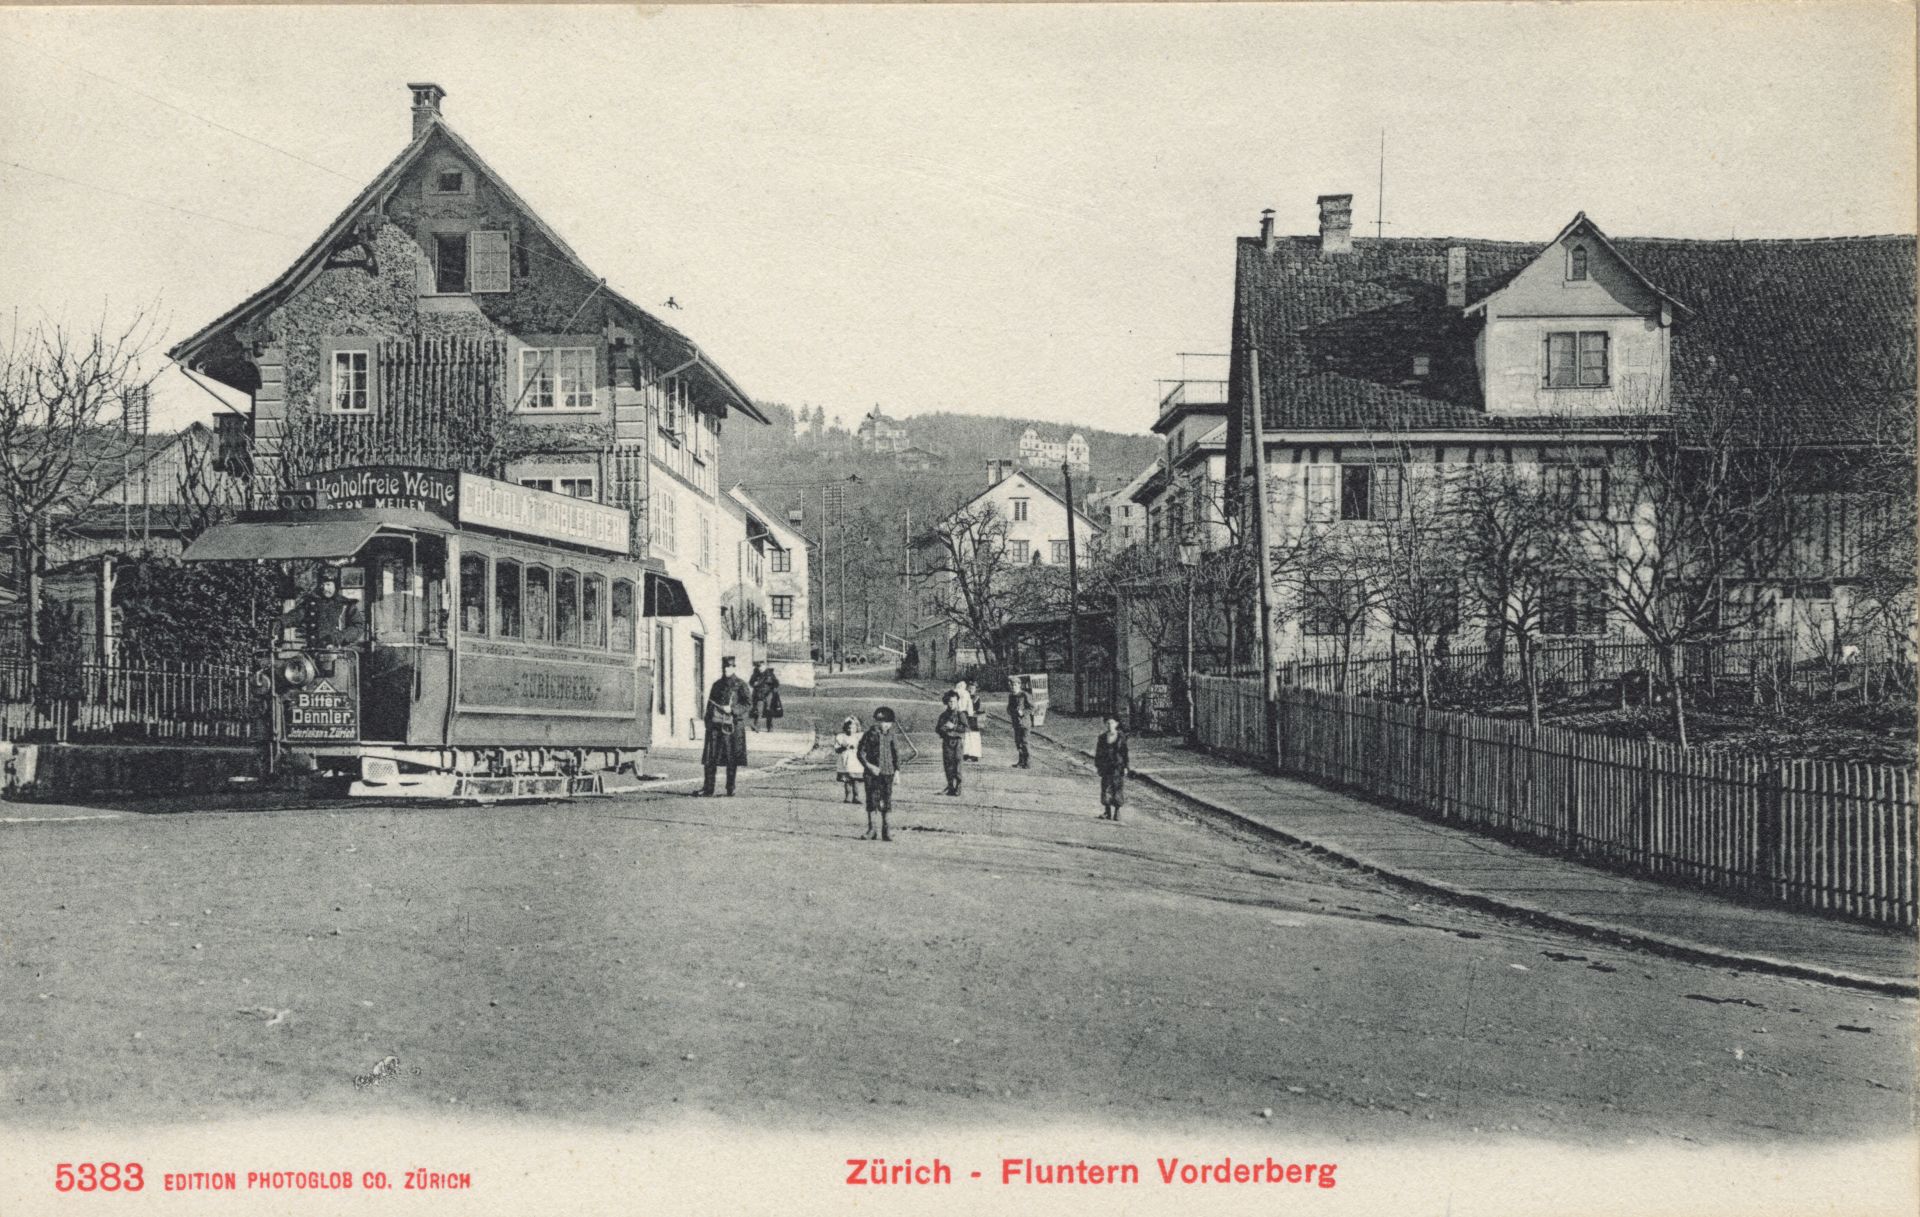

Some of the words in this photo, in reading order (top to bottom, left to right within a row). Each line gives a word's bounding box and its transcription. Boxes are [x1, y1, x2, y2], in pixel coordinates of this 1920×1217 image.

[304, 472, 400, 501] koholfreie
[402, 471, 456, 507] Weine
[374, 498, 426, 513] MEILEN
[464, 482, 538, 527] CHOCOLAT
[543, 500, 592, 538] TOBLER
[596, 511, 628, 544] BERN
[298, 693, 342, 707] Bitter
[328, 727, 356, 738] Zürich
